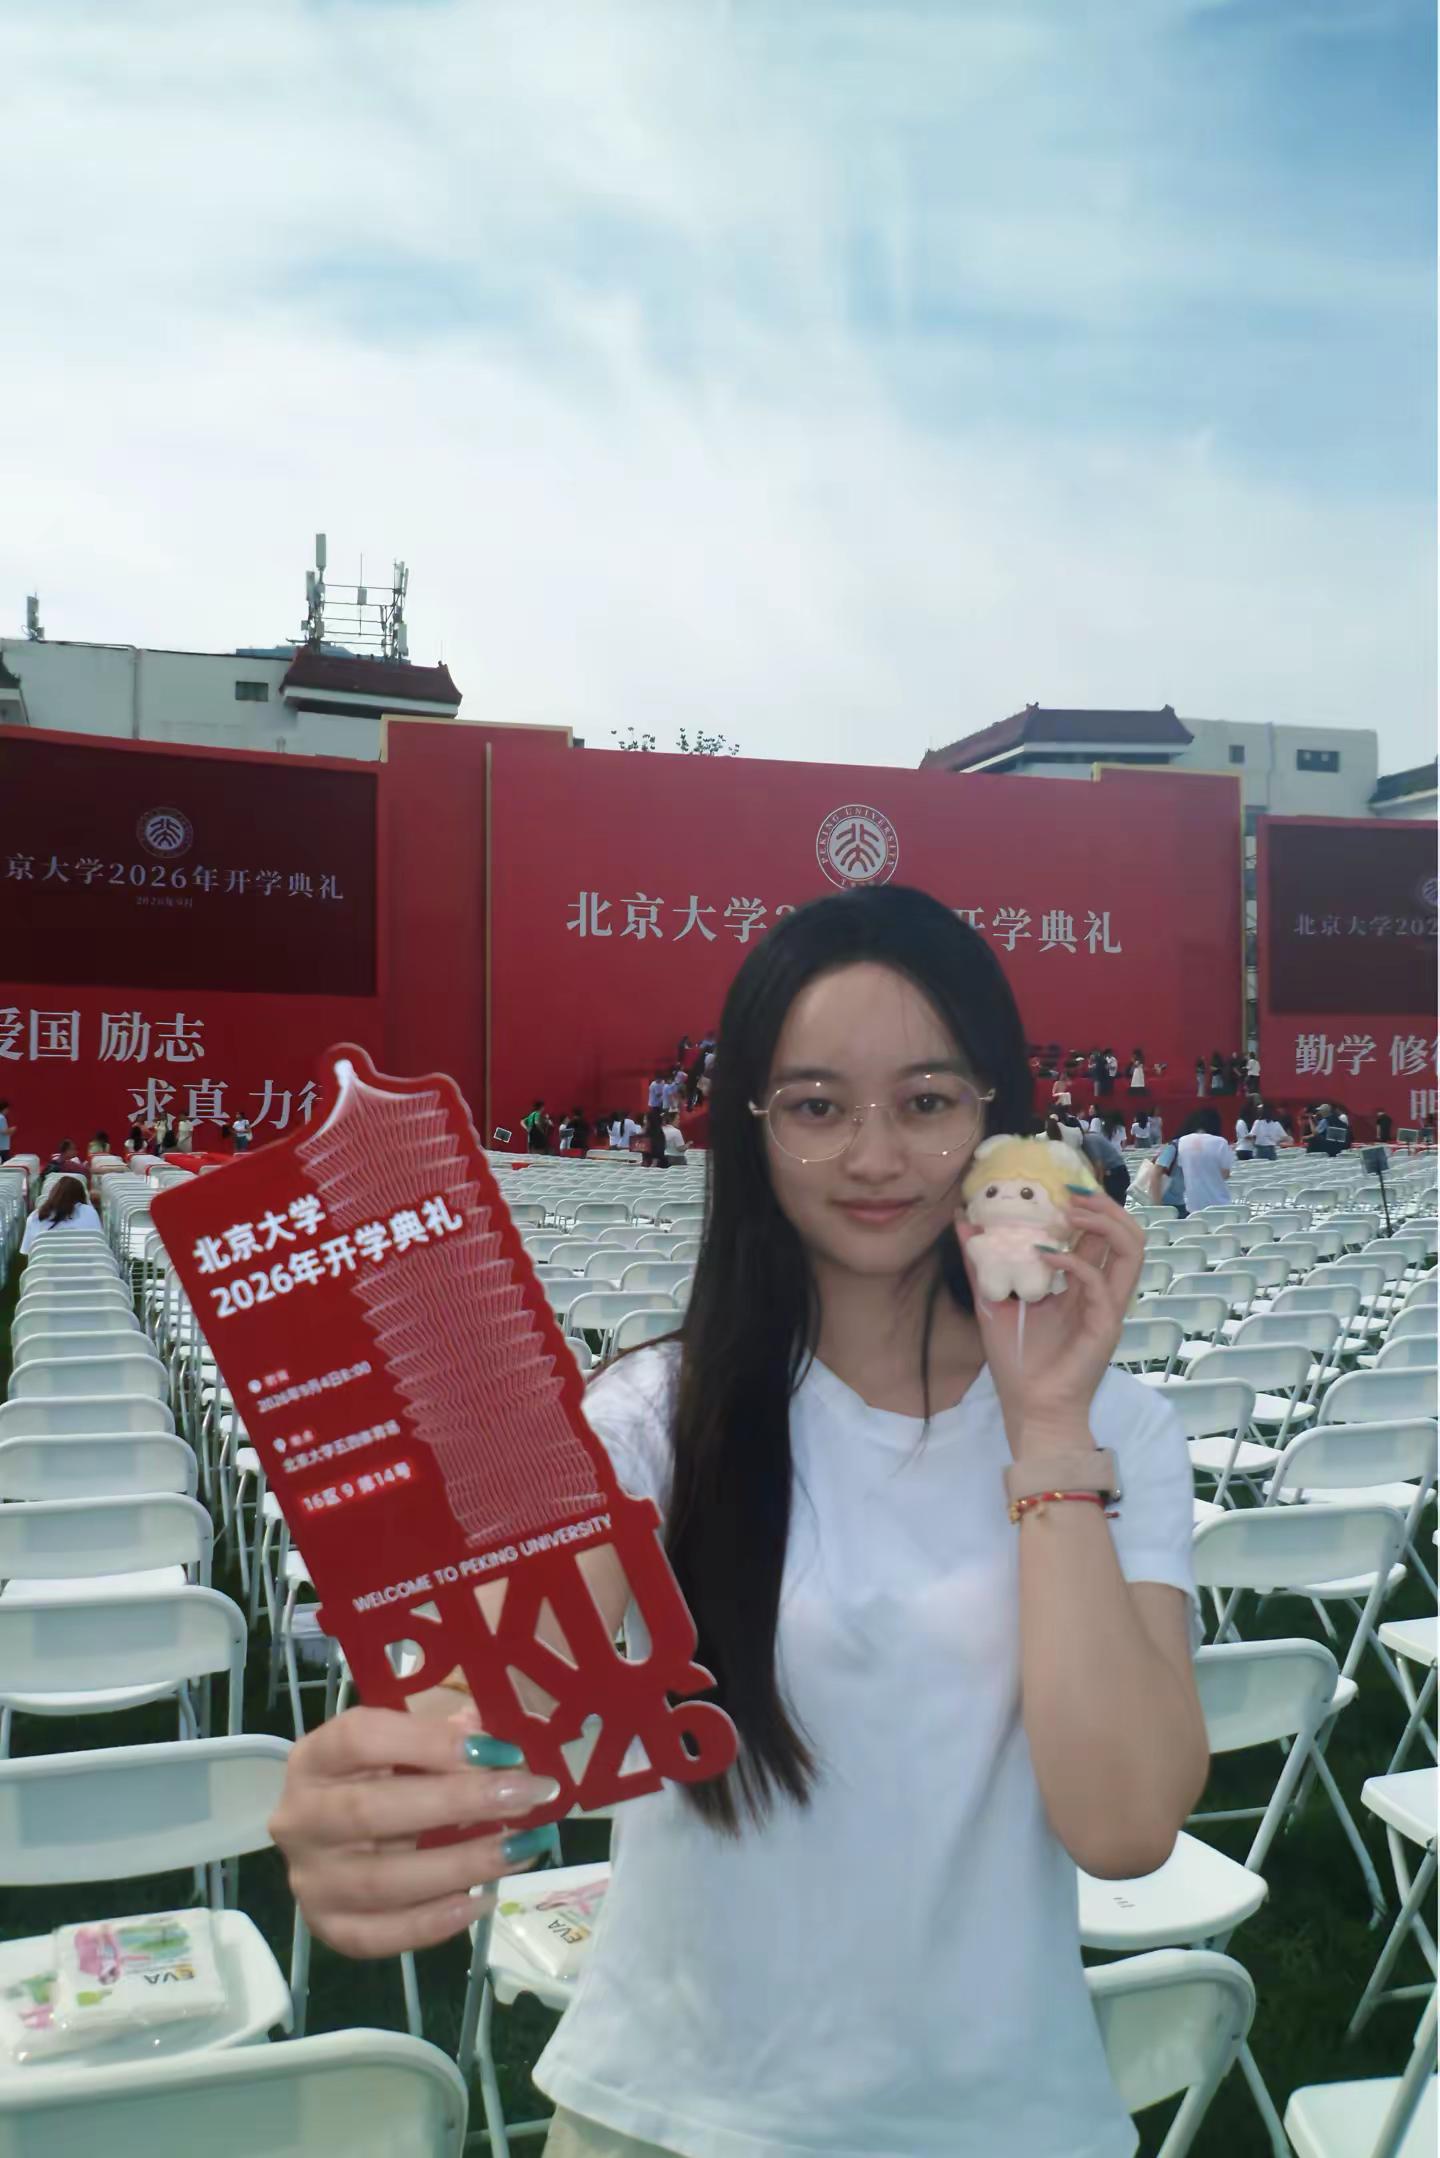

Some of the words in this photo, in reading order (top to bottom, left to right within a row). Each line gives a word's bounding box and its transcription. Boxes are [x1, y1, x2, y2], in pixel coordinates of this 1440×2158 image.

[5, 852, 345, 900] 京大学2026年开学典礼
[97, 1011, 205, 1063] 励志
[1294, 1034, 1377, 1076] 勤学
[1389, 1034, 1437, 1077] 修
[127, 1077, 230, 1129] 求真
[193, 1194, 326, 1274] 北京大学
[209, 1196, 463, 1318] 2026年开学典礼
[352, 1574, 432, 1613] WELCOME
[434, 1565, 458, 1584] TO
[459, 1546, 519, 1577] PEKING
[520, 1513, 612, 1556] UNIVERSITY
[548, 1920, 582, 1944] EVA
